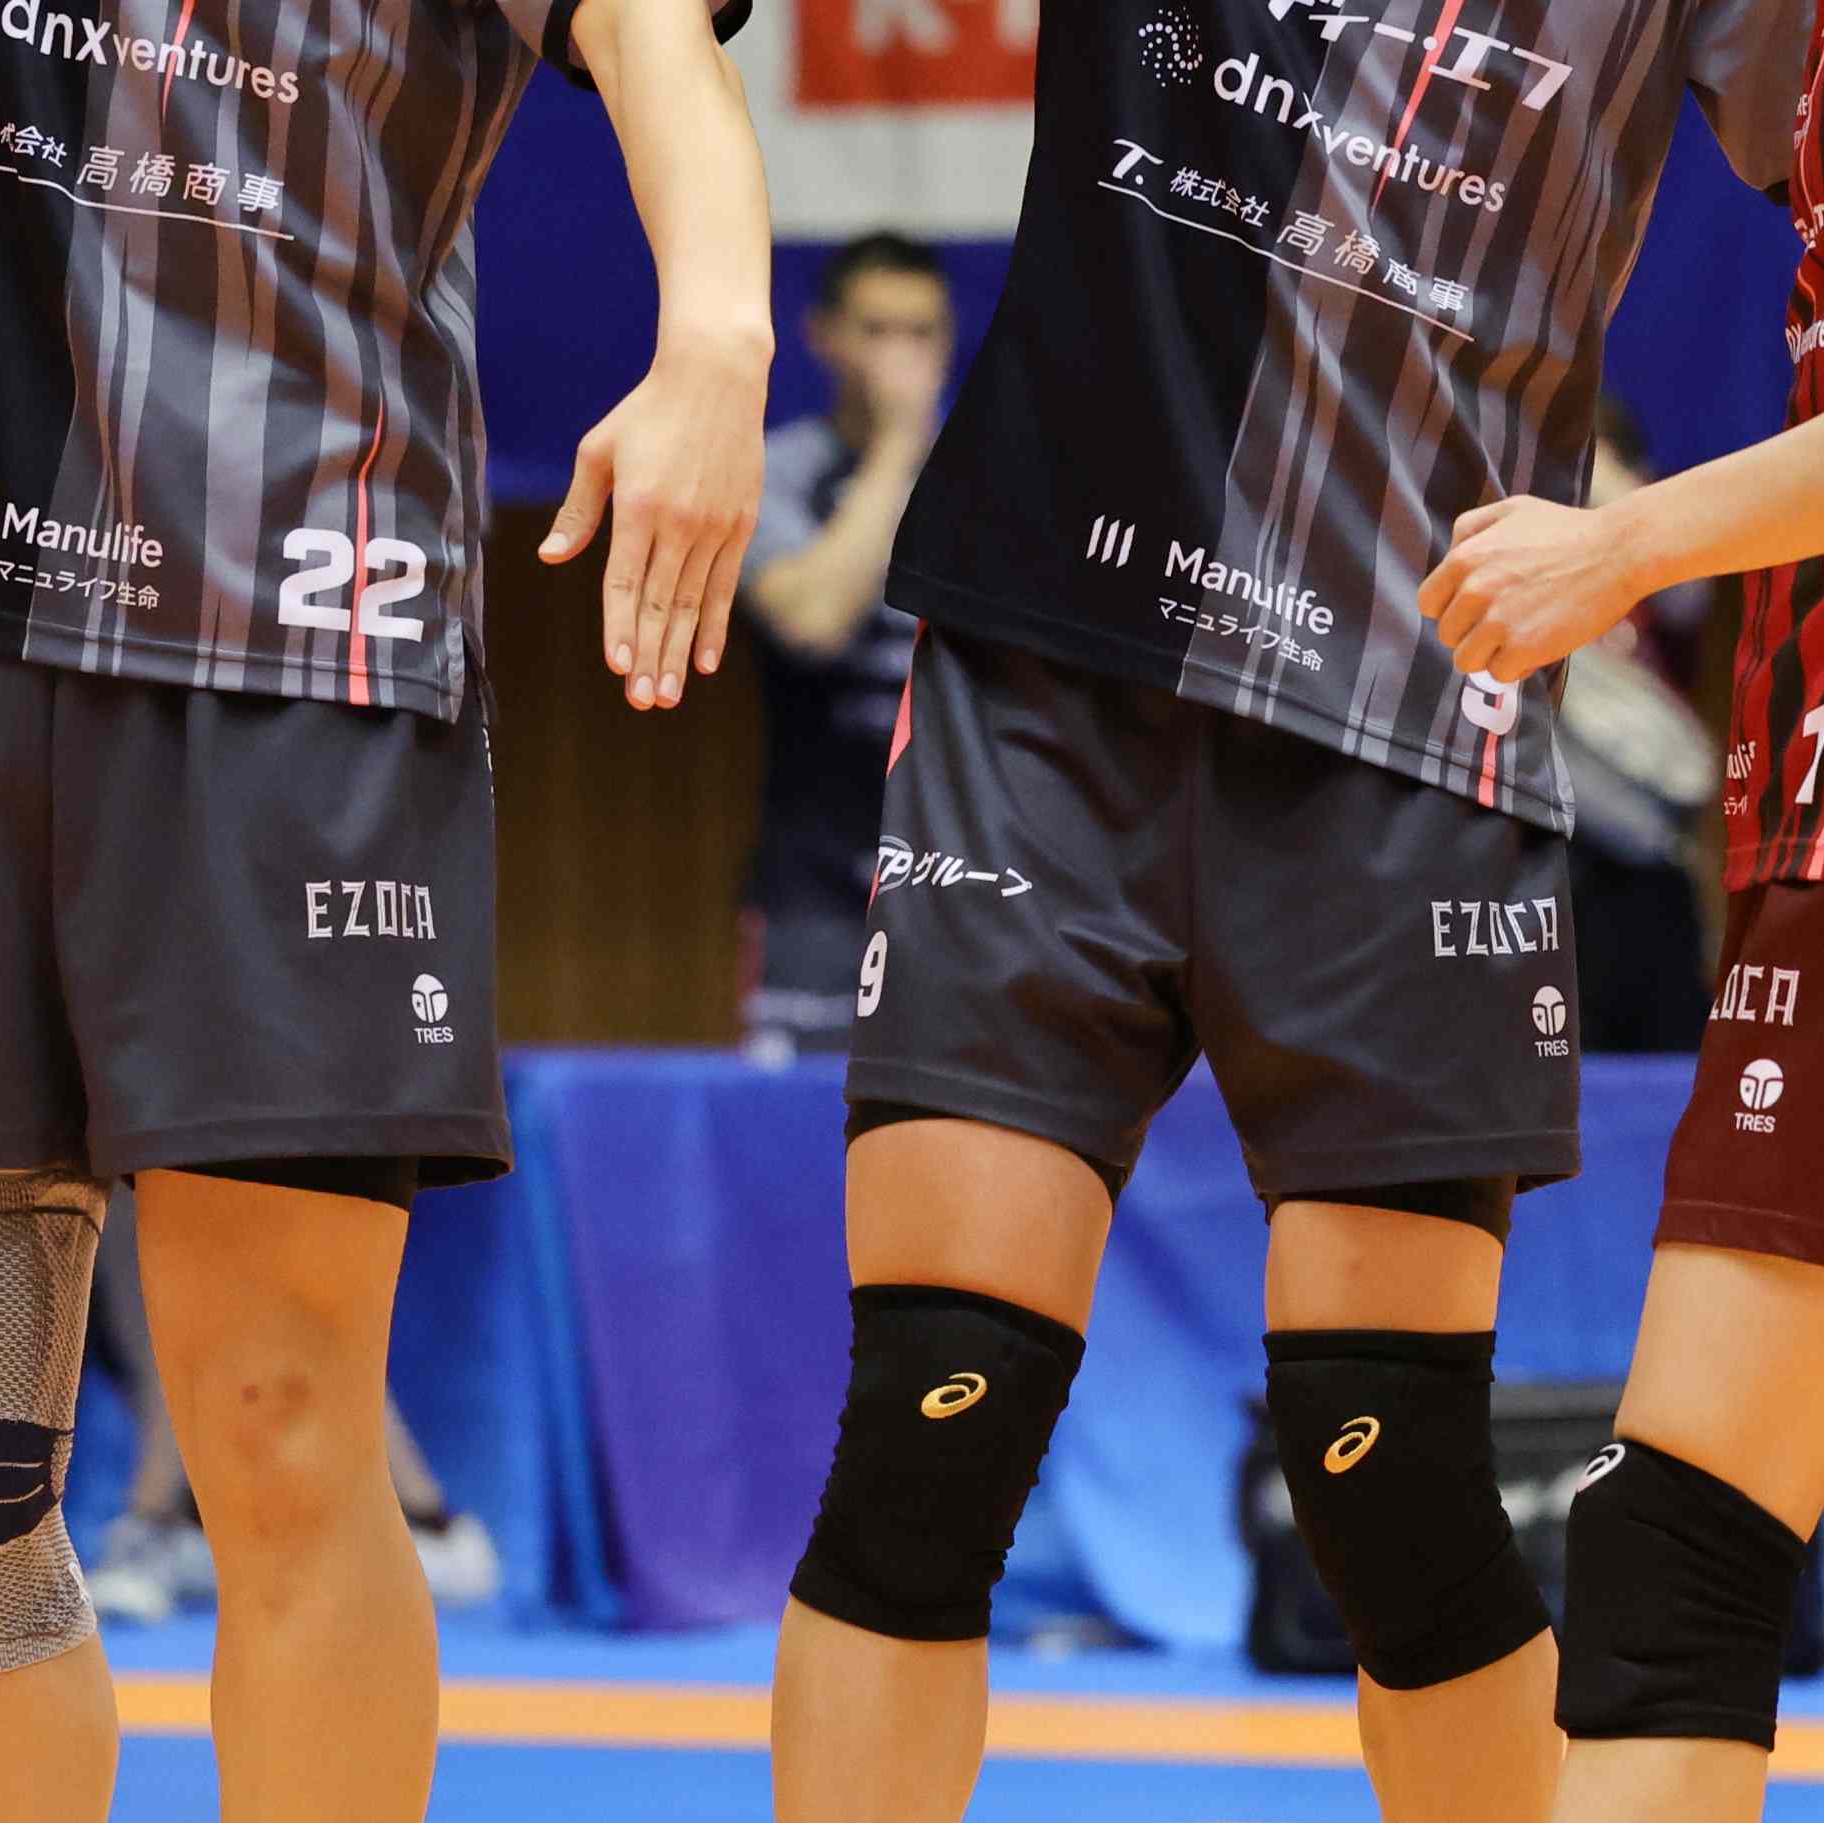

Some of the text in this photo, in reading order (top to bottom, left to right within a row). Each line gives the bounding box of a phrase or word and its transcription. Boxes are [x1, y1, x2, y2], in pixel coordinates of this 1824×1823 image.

[77, 145, 284, 212] 高橋商事
[1169, 165, 1470, 311] 株式会社 高橋商事
[0, 501, 165, 569] Manulife
[278, 527, 428, 643] 22
[1165, 540, 1335, 637] Manulife
[1157, 595, 1324, 674] マニュライフ生命
[305, 880, 437, 939] EZOCA
[1430, 896, 1560, 958] EZOCA
[857, 930, 888, 1017] 9
[414, 1027, 454, 1044] TRES
[1535, 1039, 1569, 1057] TRES
[1734, 1111, 1776, 1133] TRES
